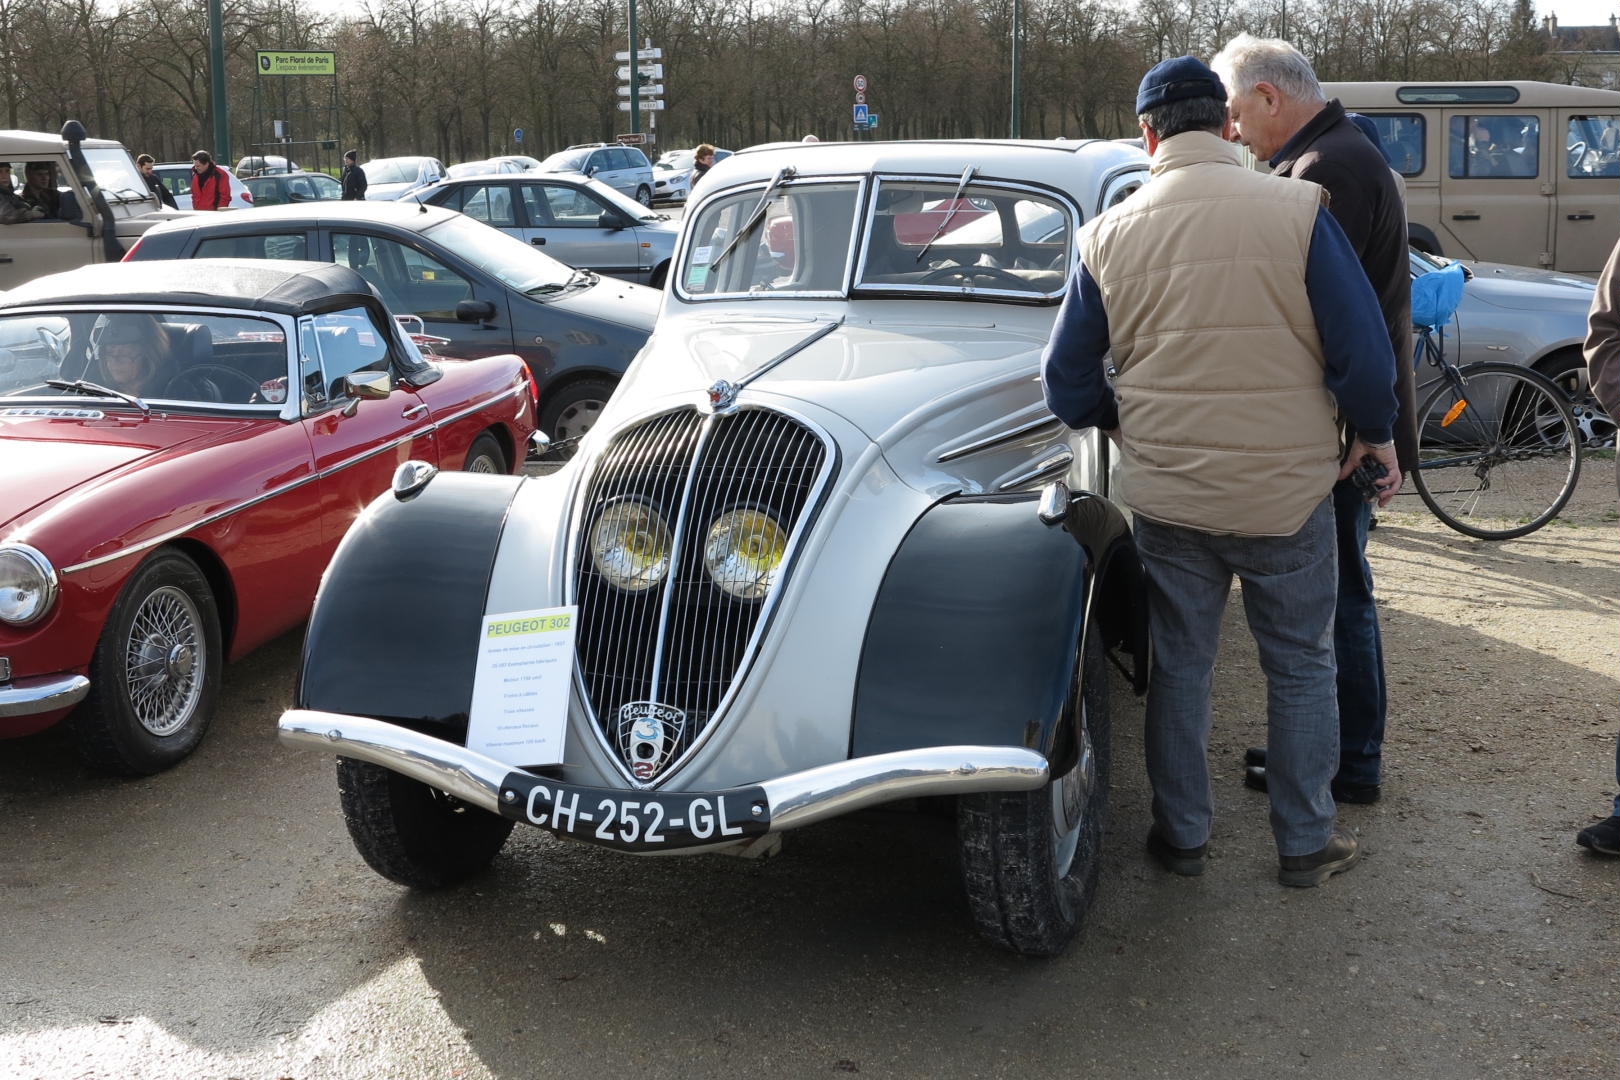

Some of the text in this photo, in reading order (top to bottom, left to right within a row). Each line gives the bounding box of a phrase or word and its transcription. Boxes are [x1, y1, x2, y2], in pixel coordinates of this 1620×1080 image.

[275, 56, 289, 64] Parc
[290, 56, 306, 64] Floral
[306, 56, 315, 64] de
[315, 56, 329, 64] Paris
[276, 64, 297, 72] L'espace
[487, 617, 571, 635] PEUGEOT 302
[526, 785, 743, 843] CH-252-GL
